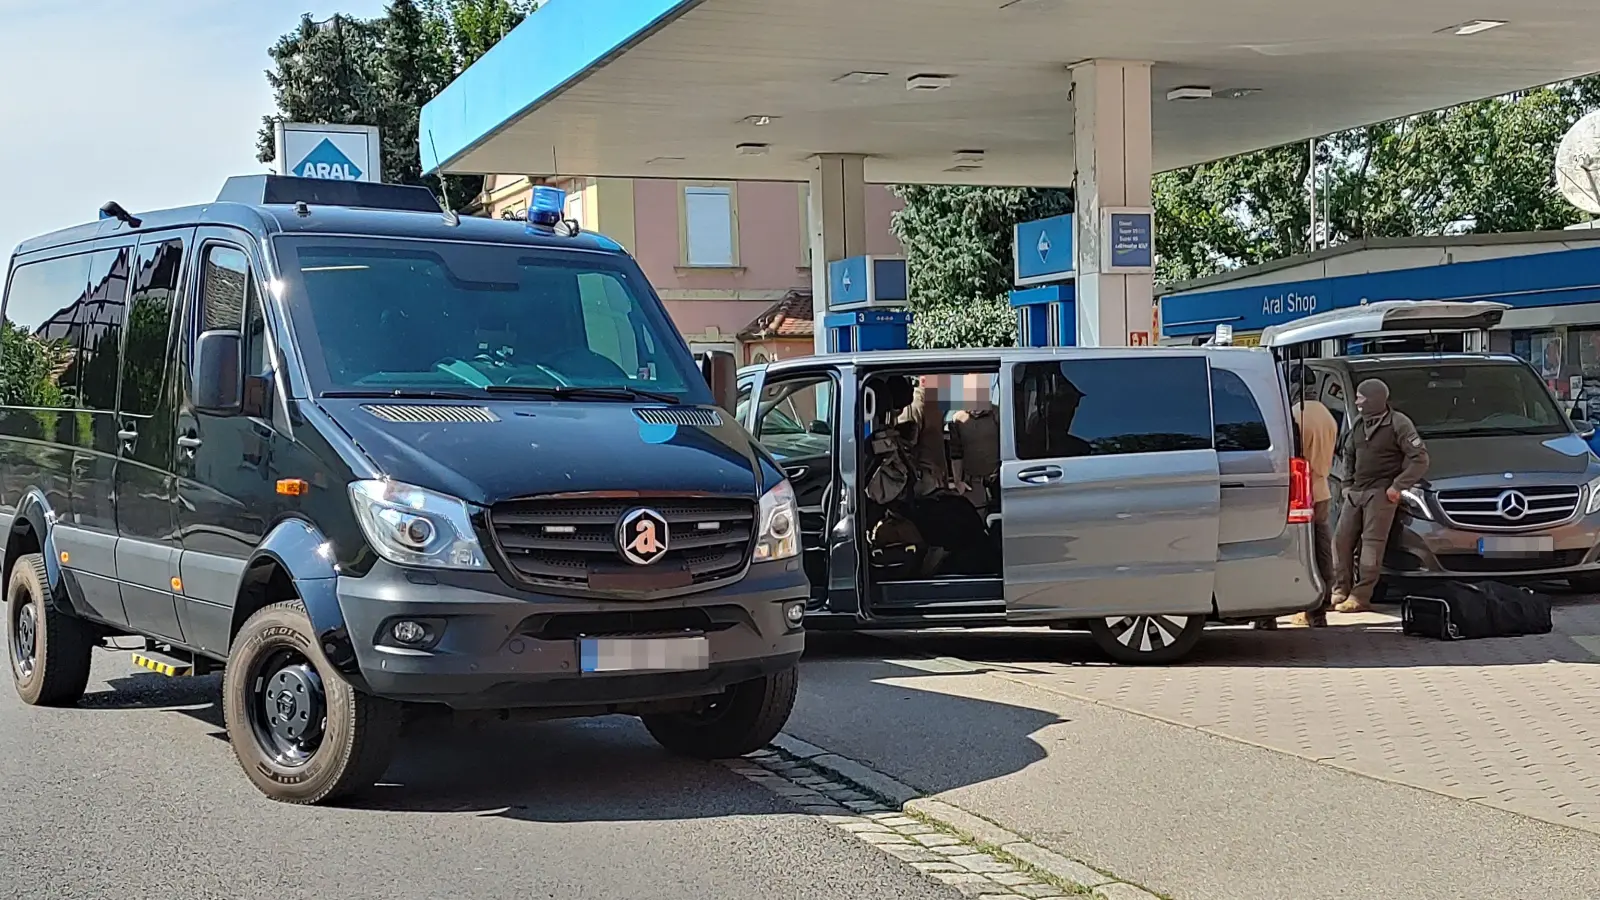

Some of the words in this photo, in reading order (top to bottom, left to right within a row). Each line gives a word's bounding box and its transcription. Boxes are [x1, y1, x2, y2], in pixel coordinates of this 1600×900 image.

[302, 162, 356, 180] ARAL
[1262, 294, 1283, 315] Aral
[1287, 292, 1316, 315] Shop
[858, 312, 865, 323] 3
[636, 519, 657, 554] a
